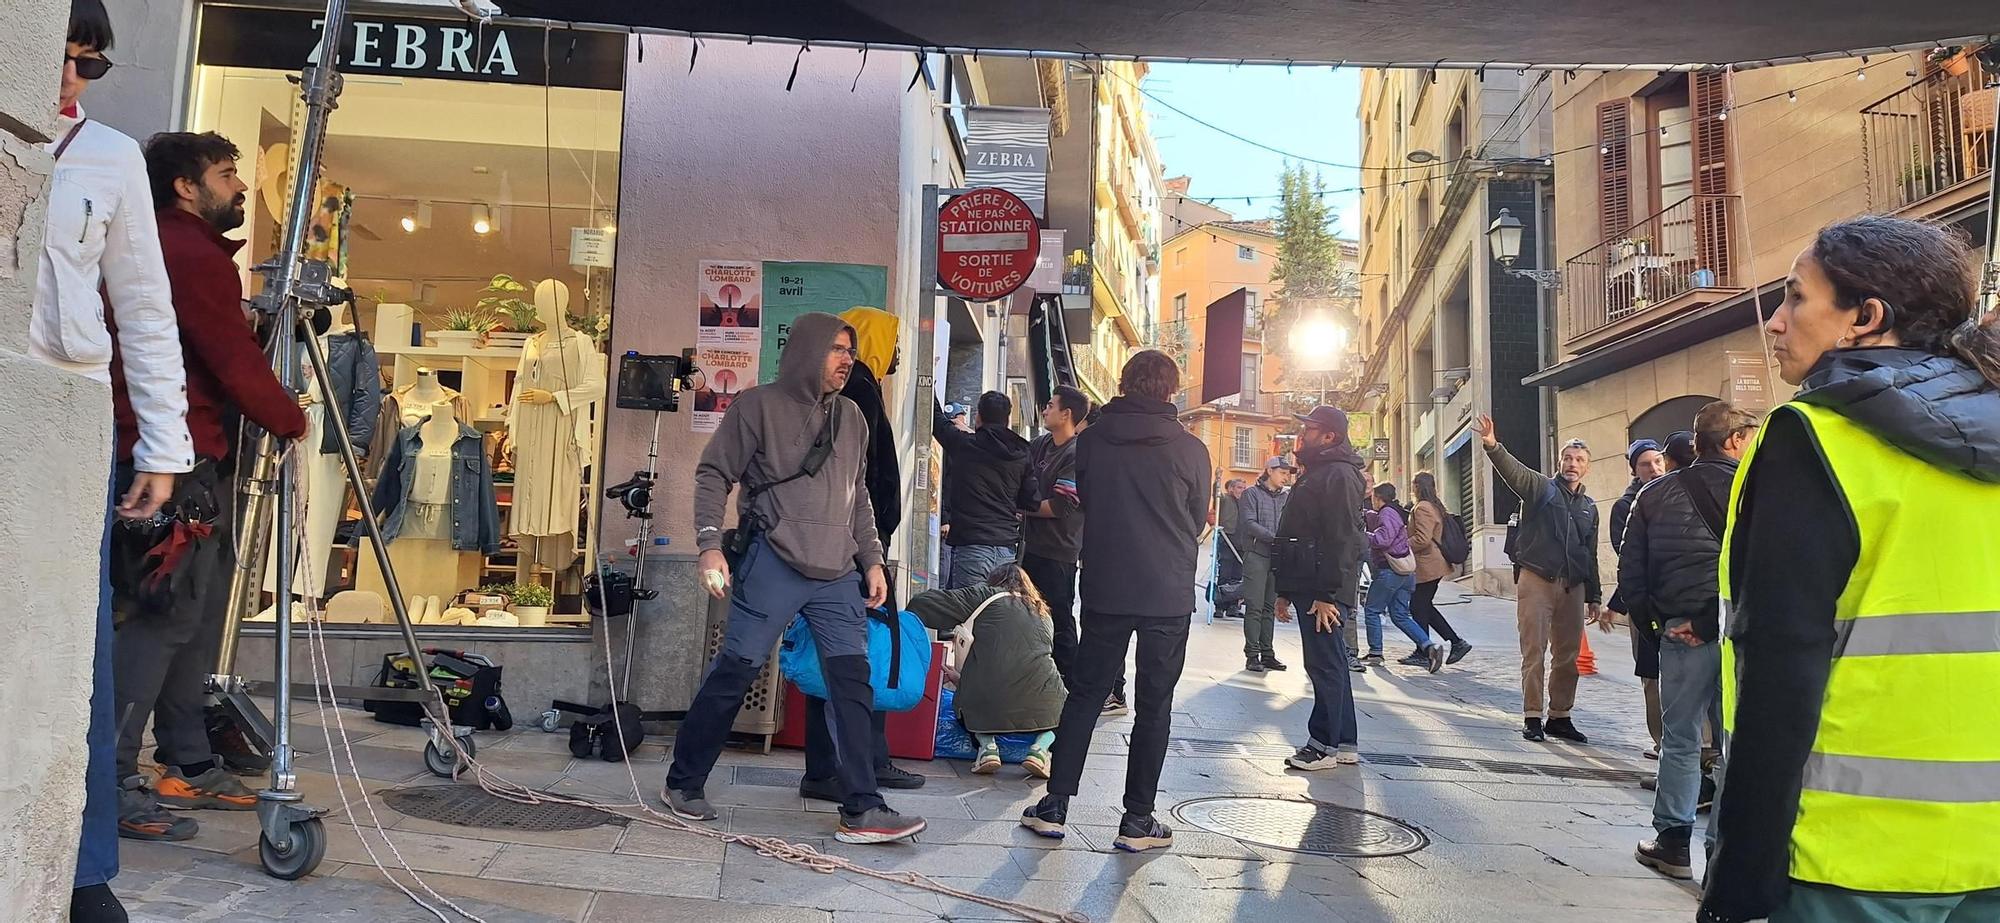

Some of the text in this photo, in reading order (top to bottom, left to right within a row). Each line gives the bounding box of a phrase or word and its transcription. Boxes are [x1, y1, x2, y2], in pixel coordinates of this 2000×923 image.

[976, 151, 1036, 167] ZEBRA
[950, 193, 1022, 218] PRIERE DE
[967, 209, 1006, 219] NE PAS
[939, 219, 1032, 233] STATIONNER
[958, 254, 1014, 267] SORTIE
[704, 268, 757, 277] CHARLOTTE
[978, 268, 993, 278] DE
[709, 275, 752, 283] LOMBARD
[950, 270, 1022, 295] VOITURES
[779, 286, 804, 297] avril
[701, 353, 753, 363] CHARLOTTE
[705, 360, 748, 369] LOMBARD
